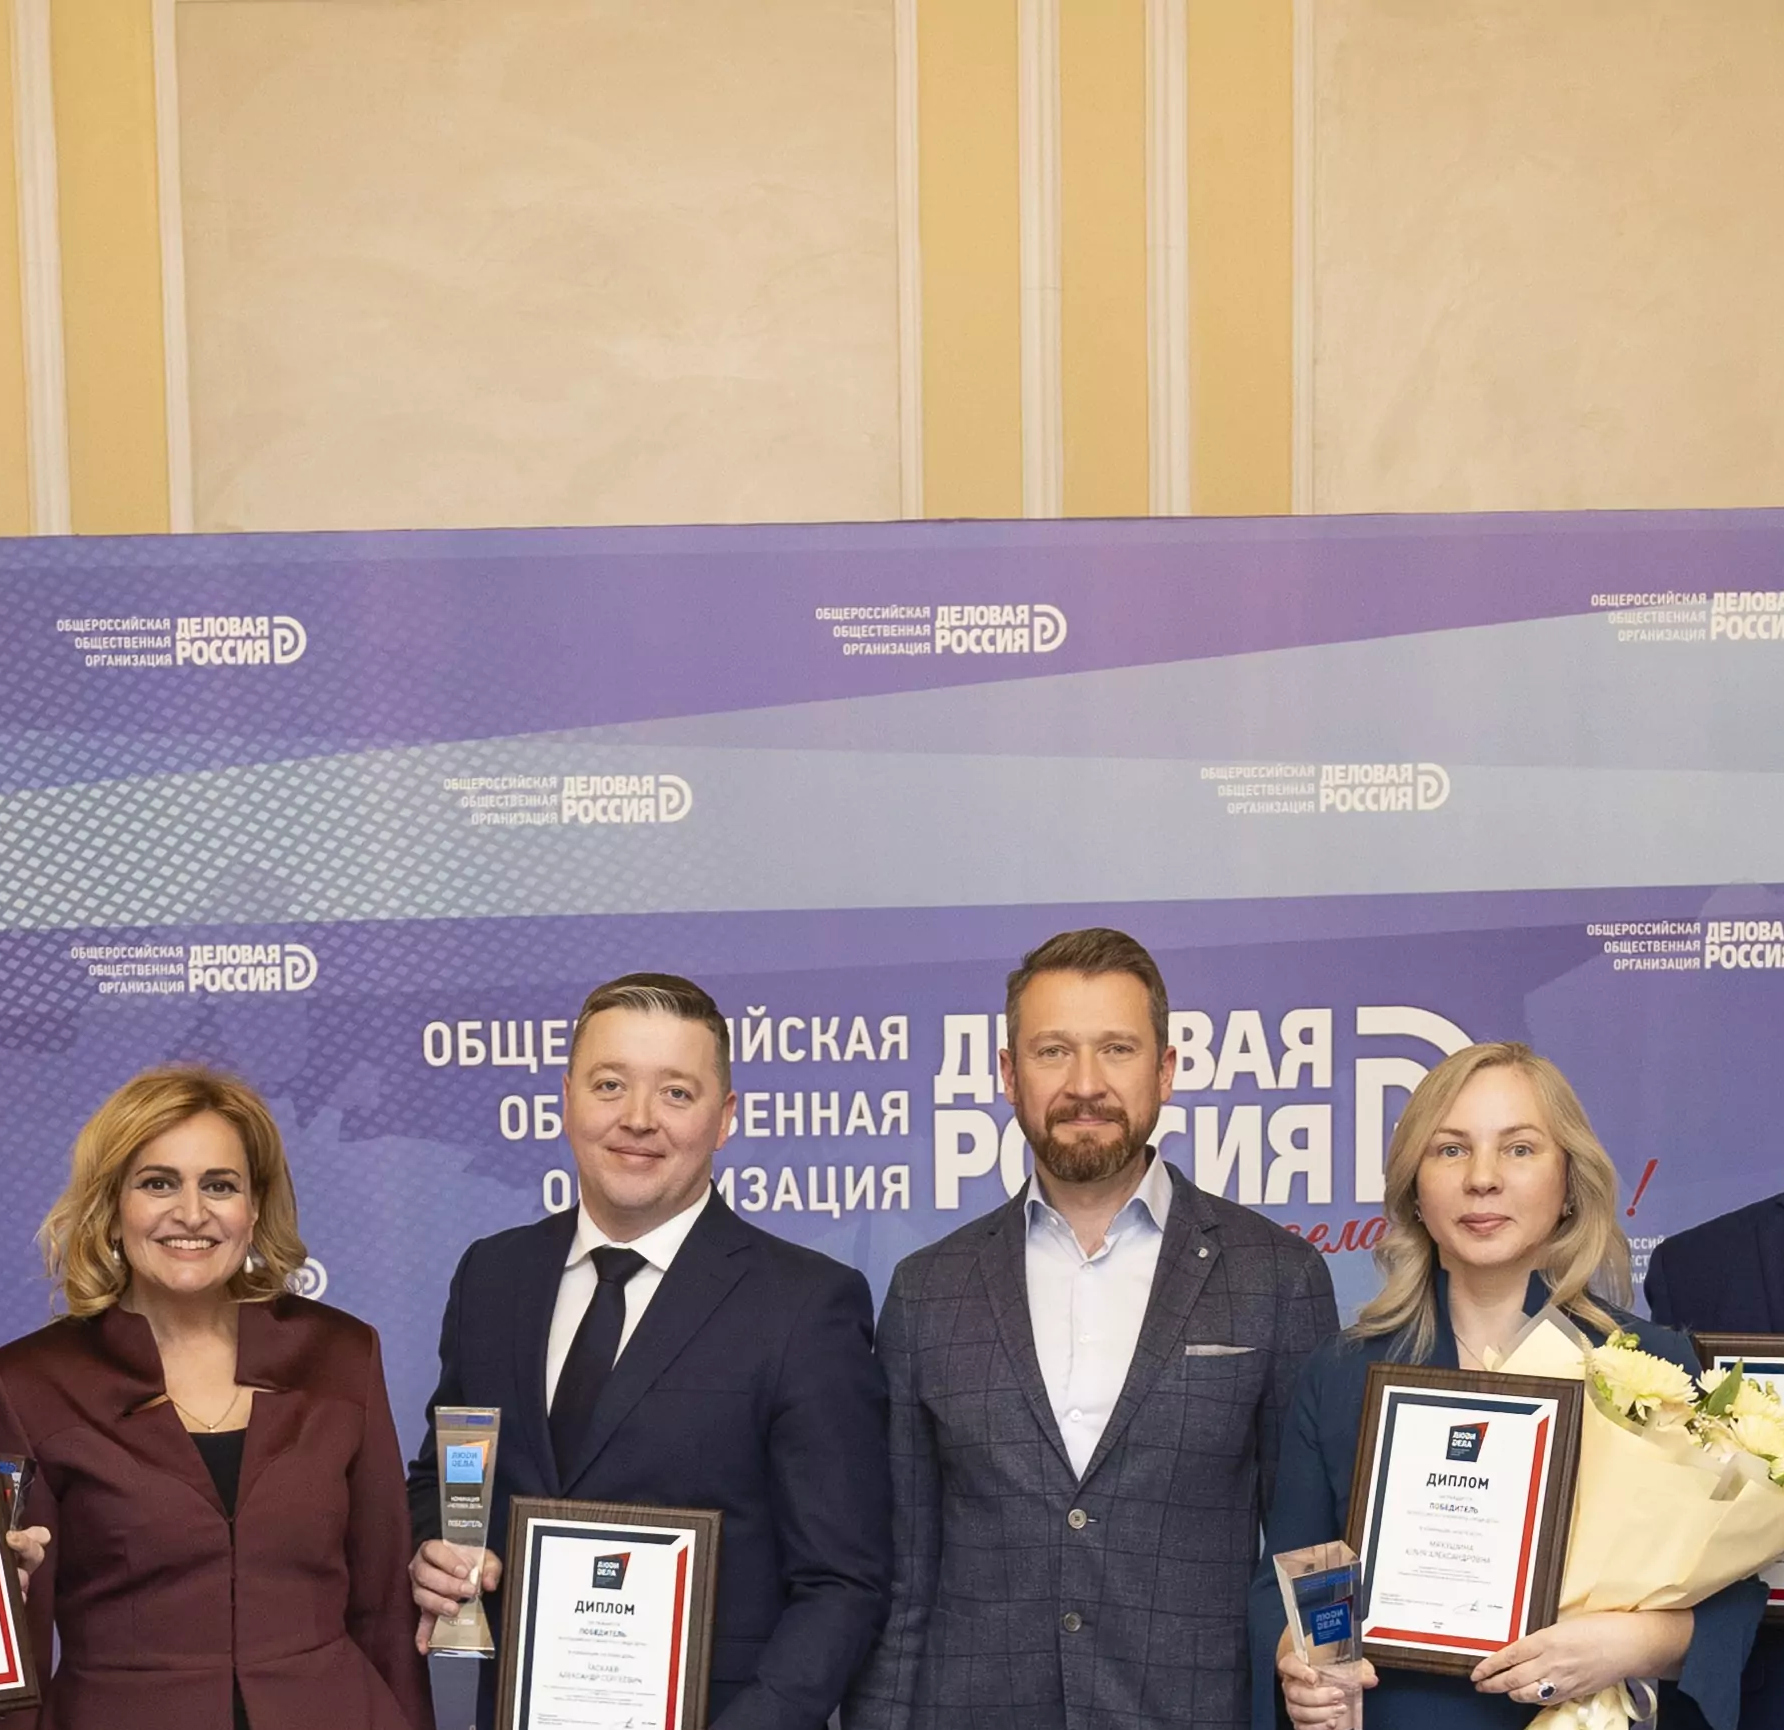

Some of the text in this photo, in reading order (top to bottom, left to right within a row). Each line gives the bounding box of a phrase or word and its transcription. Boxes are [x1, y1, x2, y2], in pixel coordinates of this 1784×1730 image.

[1591, 590, 1707, 608] ОБЩЕРОССИЙСКАЯ
[815, 604, 930, 622] ОБЩЕРОССИЙСКАЯ
[935, 605, 1029, 630] ДЕЛОВАЯ
[1608, 609, 1707, 626] ОБЩЕСТВЕННАЯ
[57, 616, 170, 633] ОБЩЕРОССИЙСКАЯ
[176, 616, 269, 641] ДЕЛОВАЯ
[833, 623, 930, 639] ОБЩЕСТВЕННАЯ
[74, 634, 171, 650] ОБЩЕСТВЕННАЯ
[935, 628, 1029, 653] РОССИЯ
[1618, 627, 1707, 643] ОРГАНИЗАЦИЯ
[176, 640, 270, 665] РОССИЯ
[843, 642, 930, 656] ОРГАНИЗАЦИЯ
[85, 653, 172, 667] ОРГАНИЗАЦИЯ
[1201, 763, 1315, 780] ОБЩЕРОССИЙСКАЯ
[1320, 763, 1413, 789] ДЕЛОВАЯ
[444, 774, 557, 791] ОБЩЕРОССИЙСКАЯ
[562, 774, 655, 799] ДЕЛОВАЯ
[1218, 782, 1315, 798] ОБЩЕСТВЕННАЯ
[461, 792, 557, 808] ОБЩЕСТВЕННАЯ
[1227, 800, 1315, 815] ОРГАНИЗАЦИЯ
[1320, 787, 1413, 812] РОССИЯ
[471, 811, 558, 826] ОРГАНИЗАЦИЯ
[563, 798, 656, 823] РОССИЯ
[1587, 921, 1701, 939] ОБЩЕРОССИЙСКАЯ
[71, 943, 183, 961] ОБЩЕРОССИЙСКАЯ
[188, 943, 280, 969] ДЕЛОВАЯ
[1604, 940, 1701, 955] ОБЩЕСТВЕННАЯ
[88, 961, 184, 977] ОБЩЕСТВЕННАЯ
[1614, 956, 1701, 971] ОРГАНИЗАЦИЯ
[98, 979, 184, 994] ОРГАНИЗАЦИЯ
[189, 967, 281, 992] РОССИЯ
[423, 1006, 908, 1074] ОБЩЕЙСКАЯ
[934, 1009, 1333, 1105] ДВАЯ
[500, 1091, 908, 1140] ОБВЕННАЯ
[543, 1165, 909, 1218] ОИЗАЦИЯ
[1426, 1473, 1490, 1490] ДИПЛОМ
[1429, 1502, 1479, 1514] ПОБЕДИТЕЛЬ
[575, 1600, 635, 1616] ДИПЛОМ
[579, 1628, 627, 1638] ПОБЕДИТЕЛЬ
